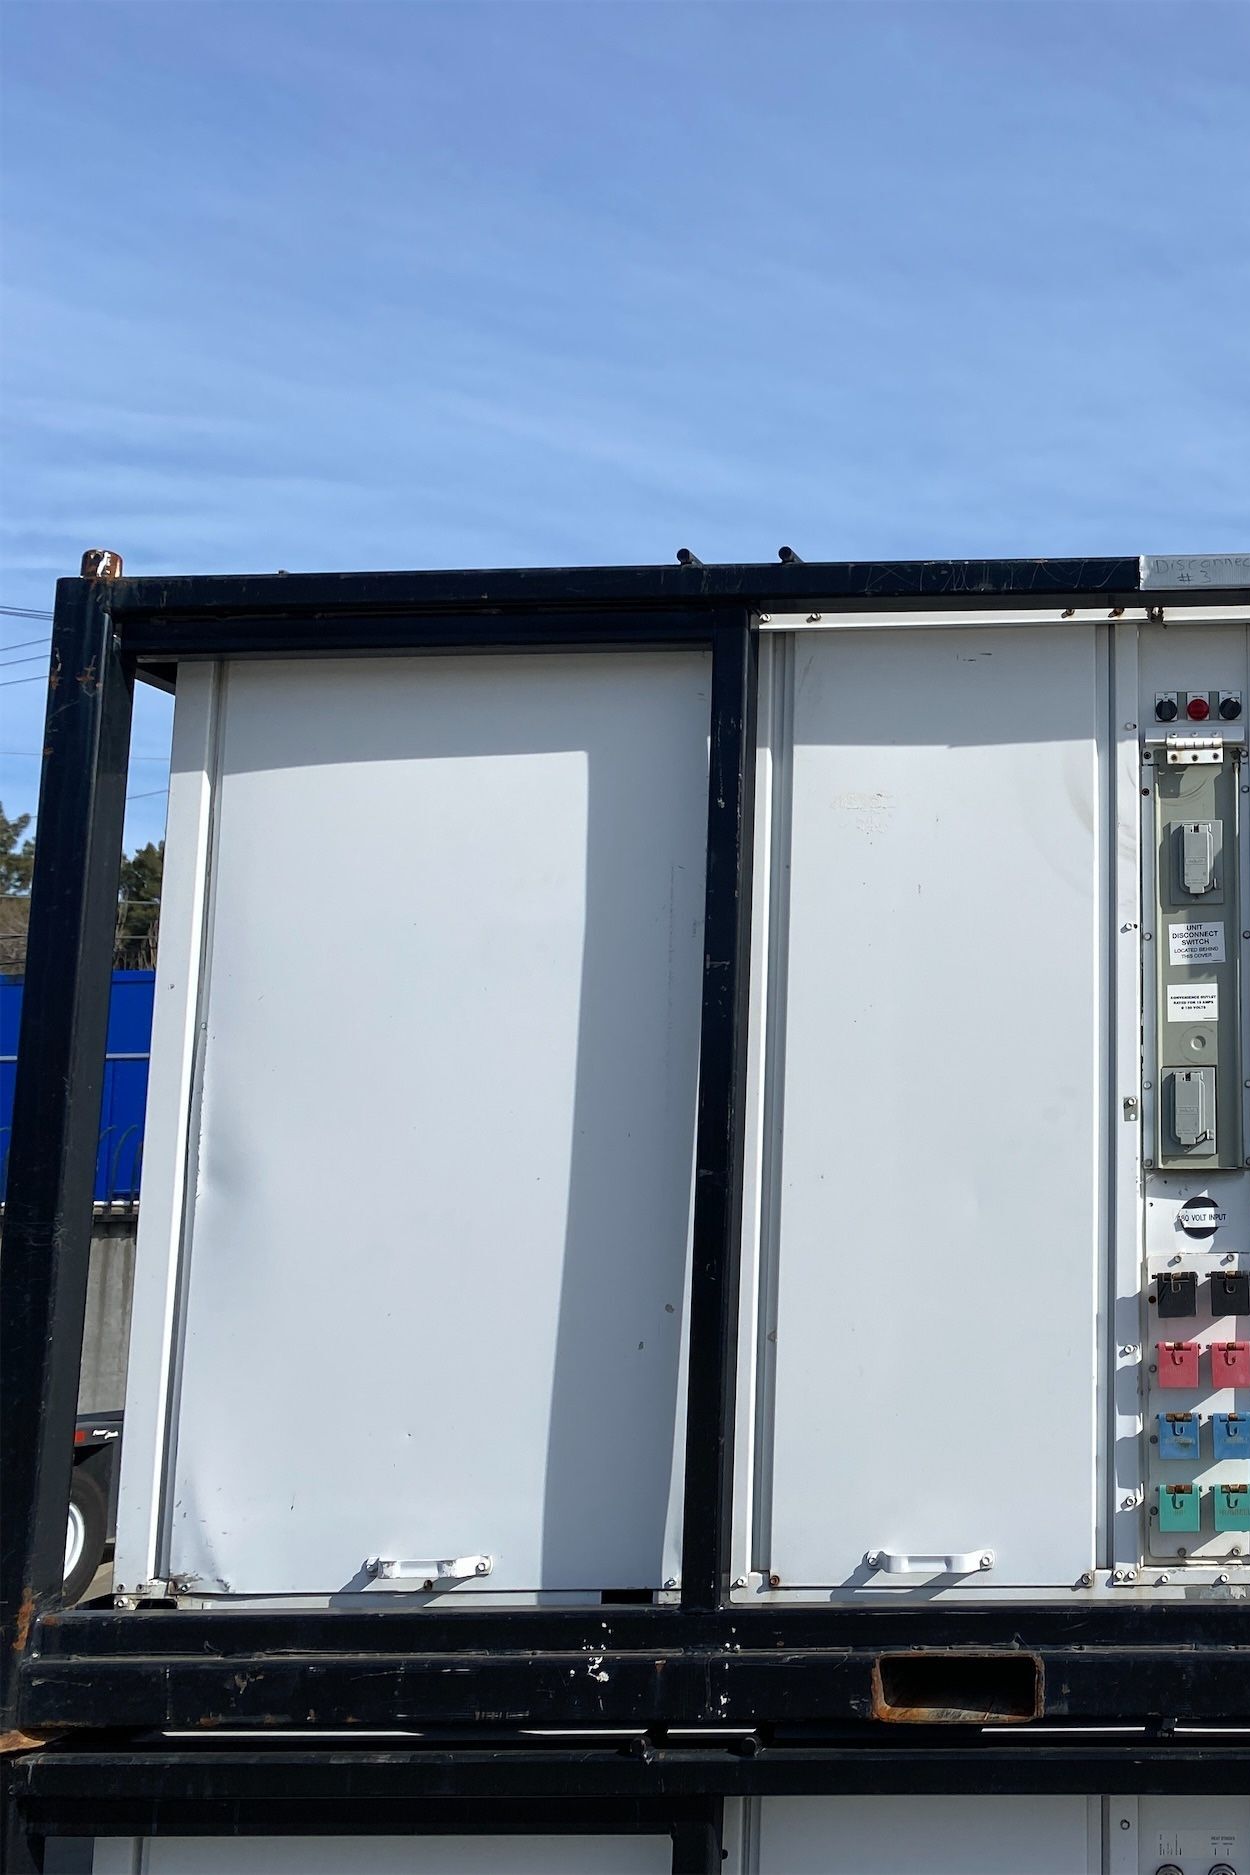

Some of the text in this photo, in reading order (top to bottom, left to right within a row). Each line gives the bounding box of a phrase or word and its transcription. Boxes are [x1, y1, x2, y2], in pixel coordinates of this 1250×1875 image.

[1177, 570, 1212, 584] # 3
[1172, 931, 1219, 939] DISCONNECT
[1181, 938, 1210, 946] SWITCH
[1208, 1213, 1227, 1221] INPUT
